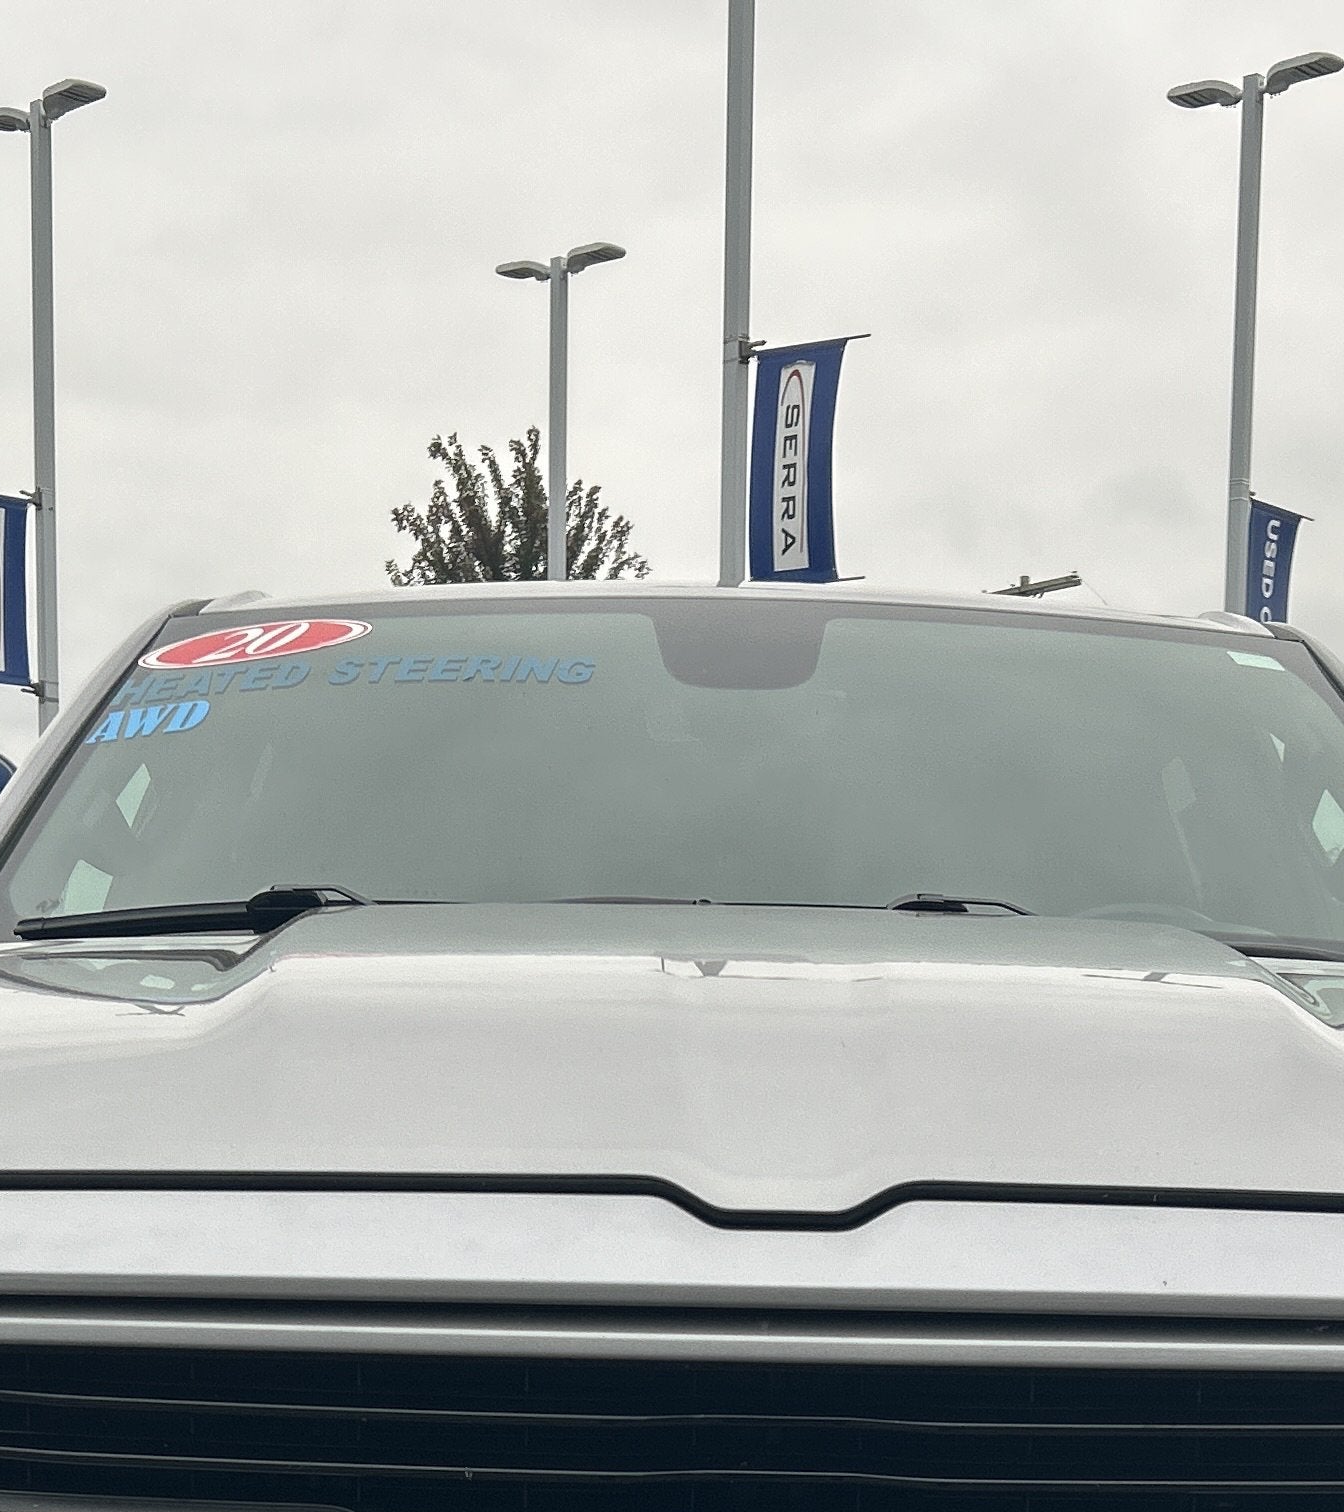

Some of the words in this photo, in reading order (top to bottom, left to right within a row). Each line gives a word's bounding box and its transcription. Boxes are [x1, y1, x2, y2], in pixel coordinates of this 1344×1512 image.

[781, 404, 800, 556] SERRA
[1261, 519, 1281, 599] USED
[192, 622, 311, 664] 20
[110, 661, 312, 706] HEATED
[328, 654, 597, 686] STEERING
[85, 699, 212, 745] AWD
